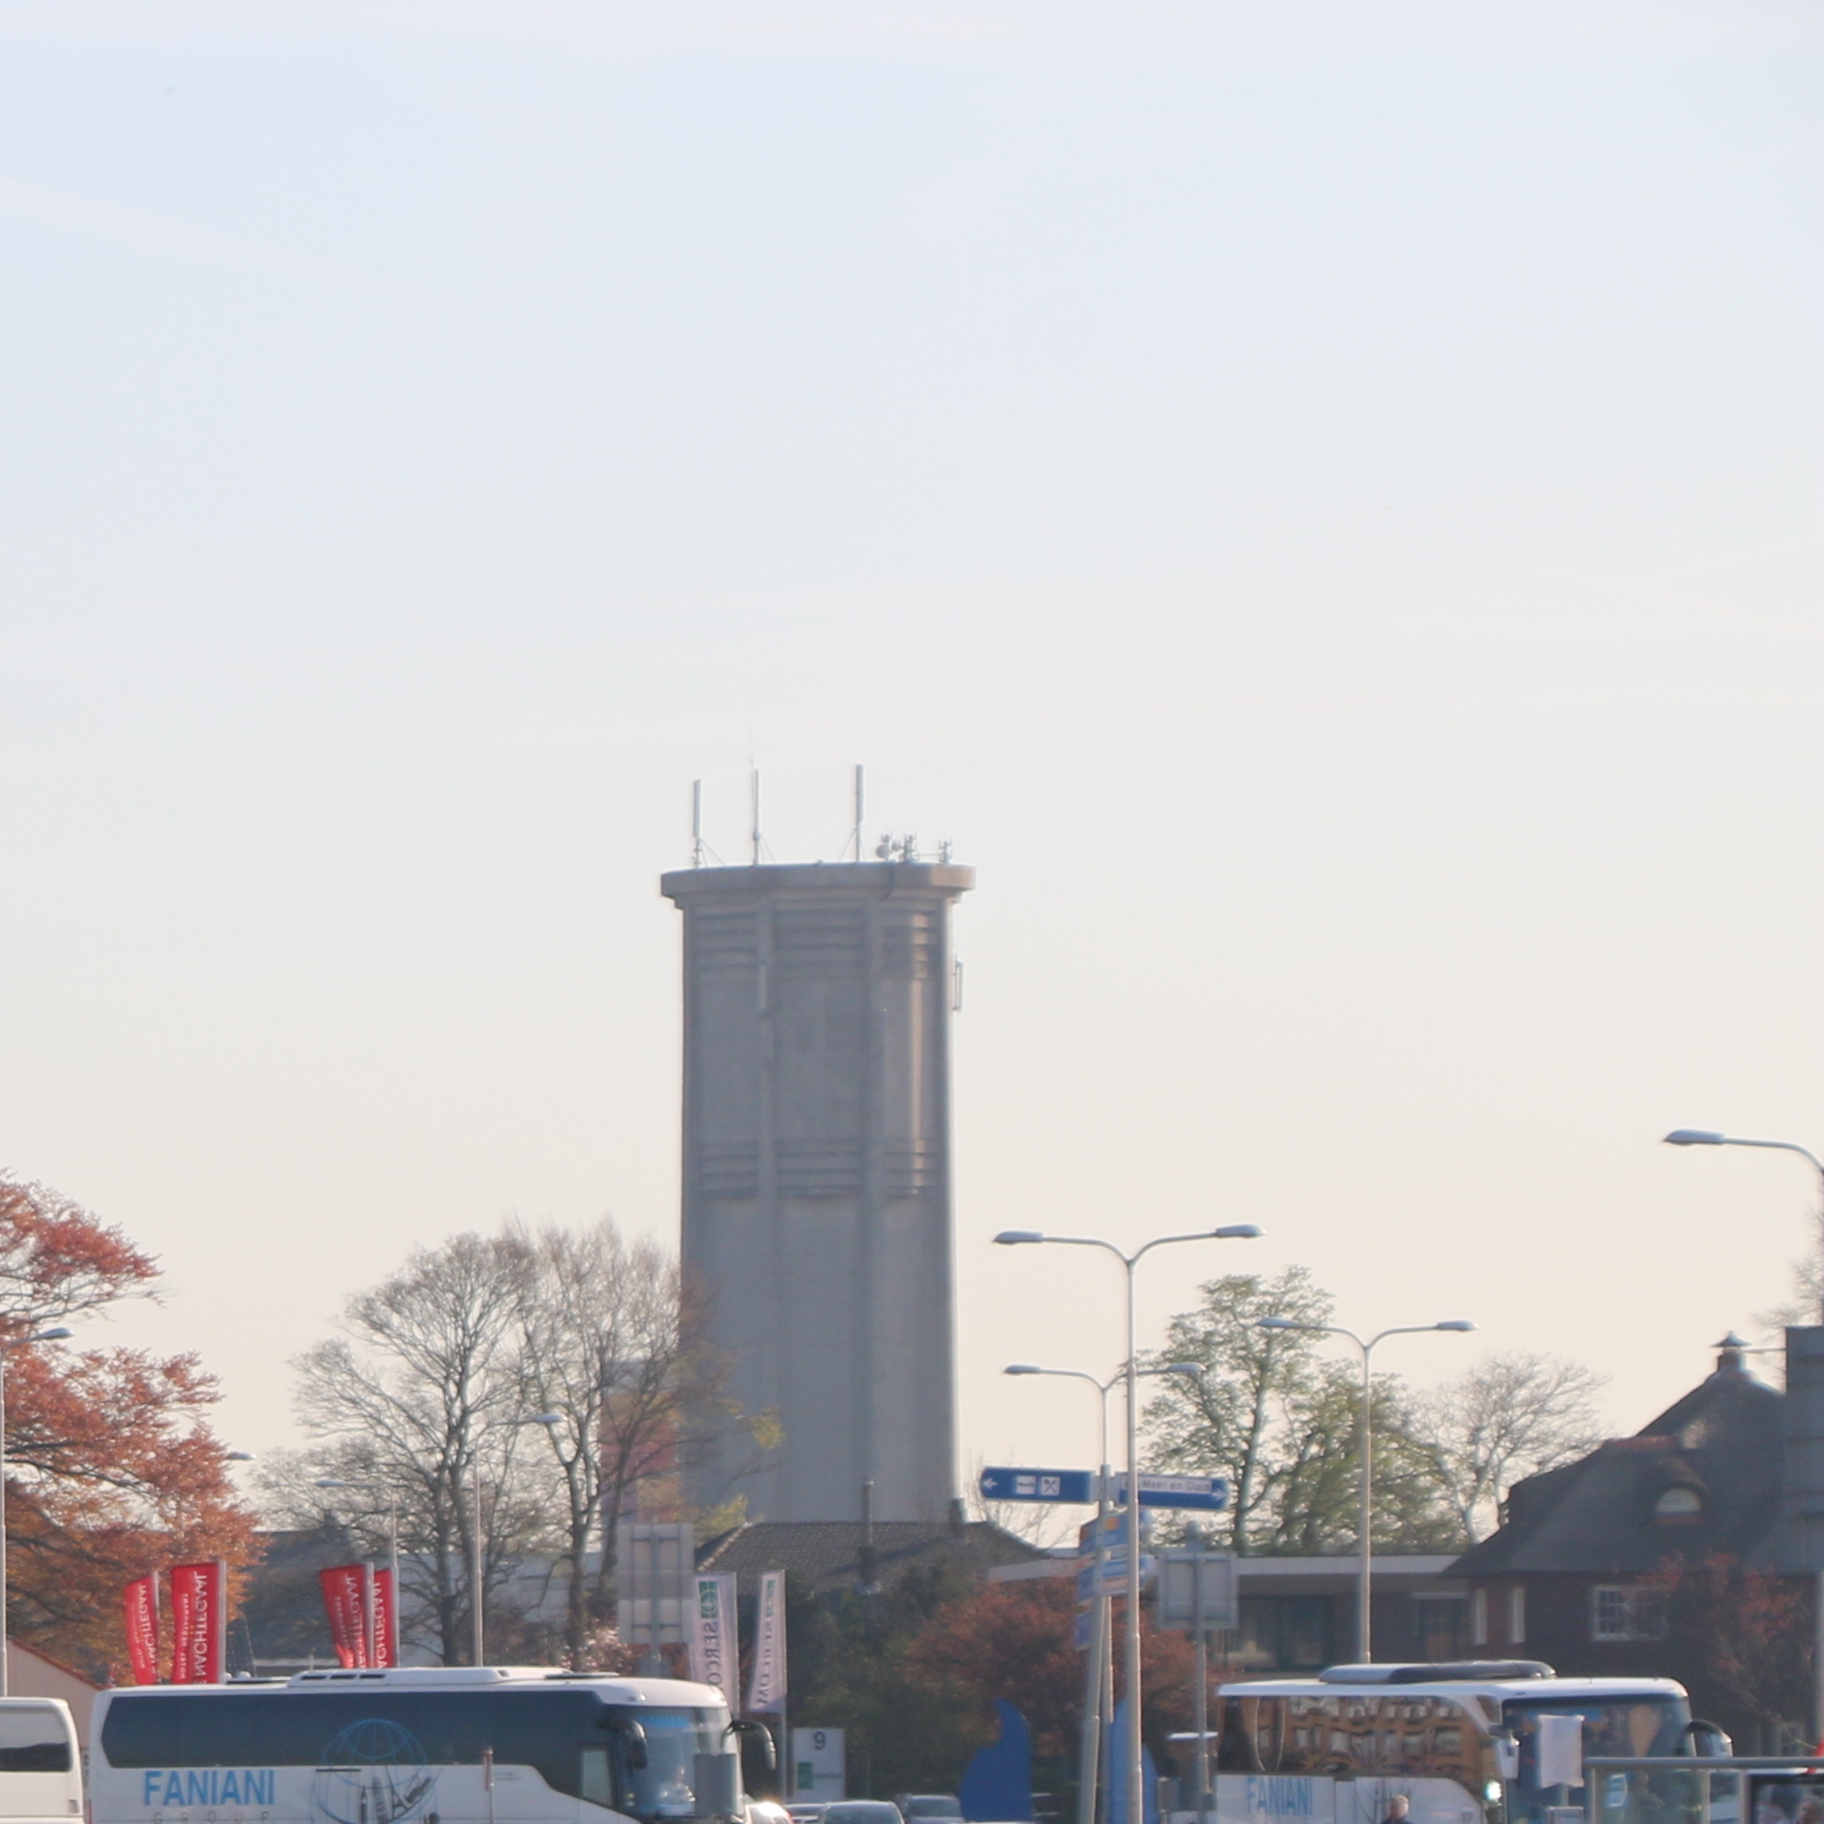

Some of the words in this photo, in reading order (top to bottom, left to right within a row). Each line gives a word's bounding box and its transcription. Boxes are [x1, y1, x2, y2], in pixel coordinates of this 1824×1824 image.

[814, 1731, 827, 1751] 9
[144, 1769, 275, 1806] FANIANI
[1247, 1776, 1313, 1816] FANIANI
